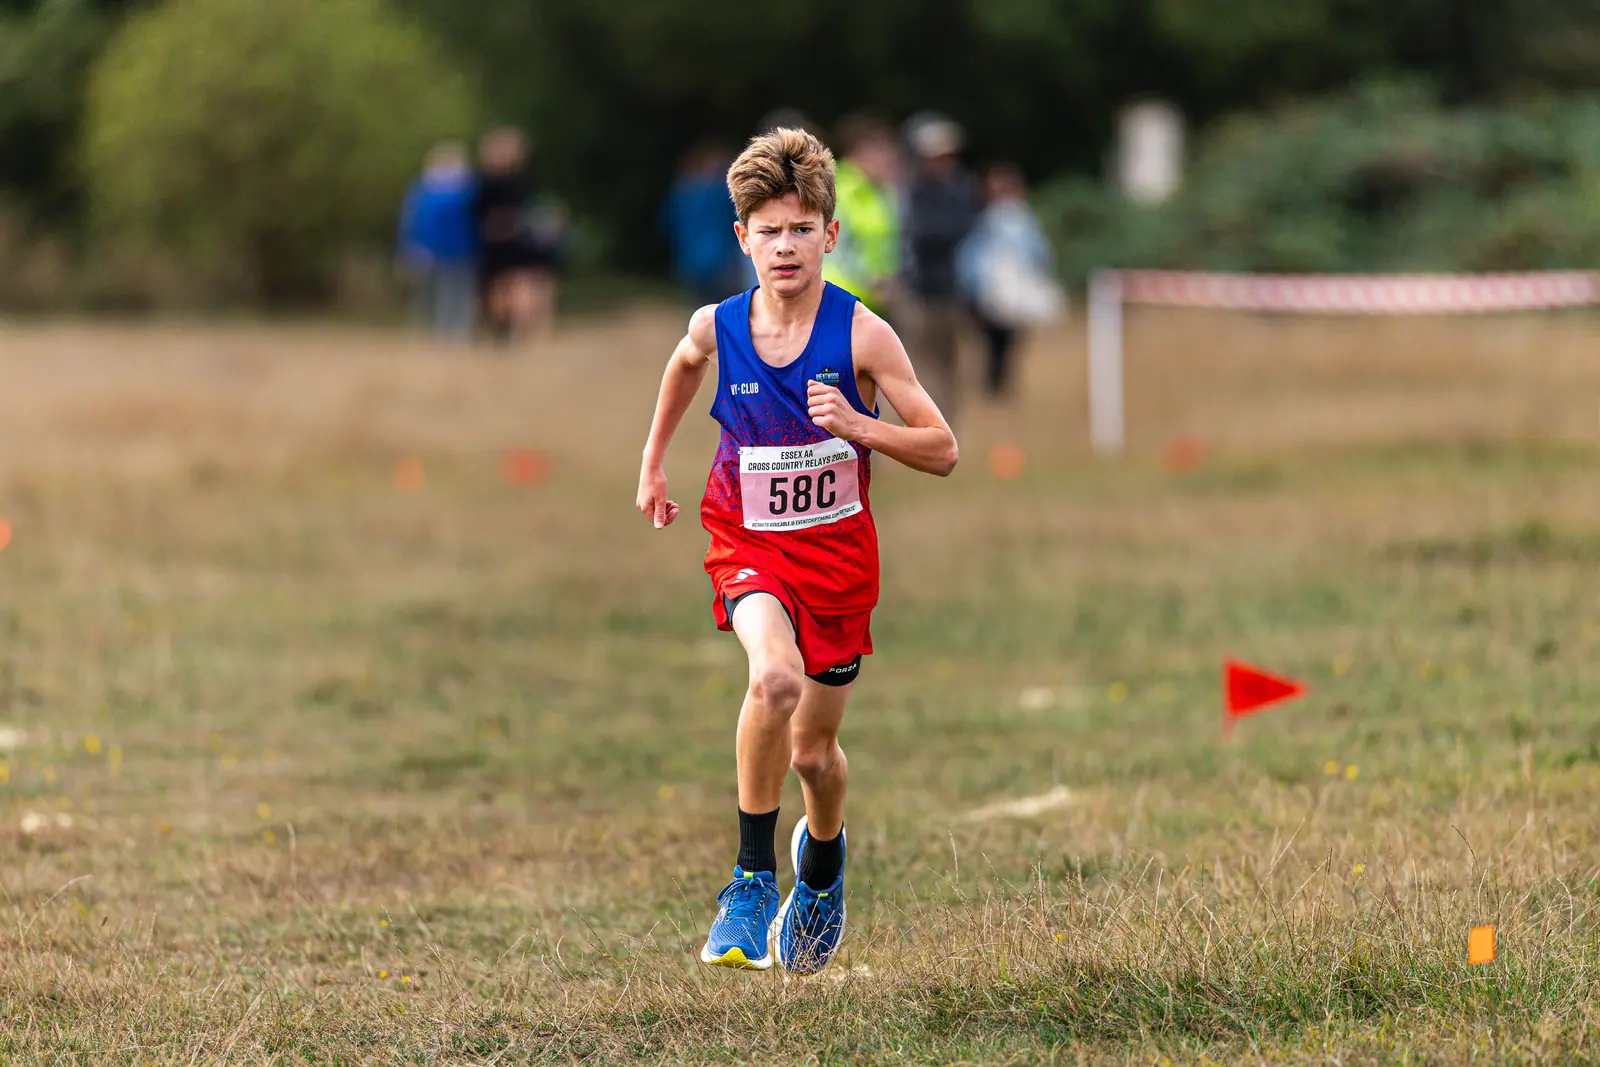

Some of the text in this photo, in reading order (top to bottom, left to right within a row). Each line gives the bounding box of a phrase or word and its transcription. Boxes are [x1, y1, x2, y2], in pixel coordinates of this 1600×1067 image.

[748, 451, 849, 471] CROSS COUNTRY RELAYS 2026
[781, 449, 814, 460] ESSEX AA
[769, 469, 836, 515] 58C
